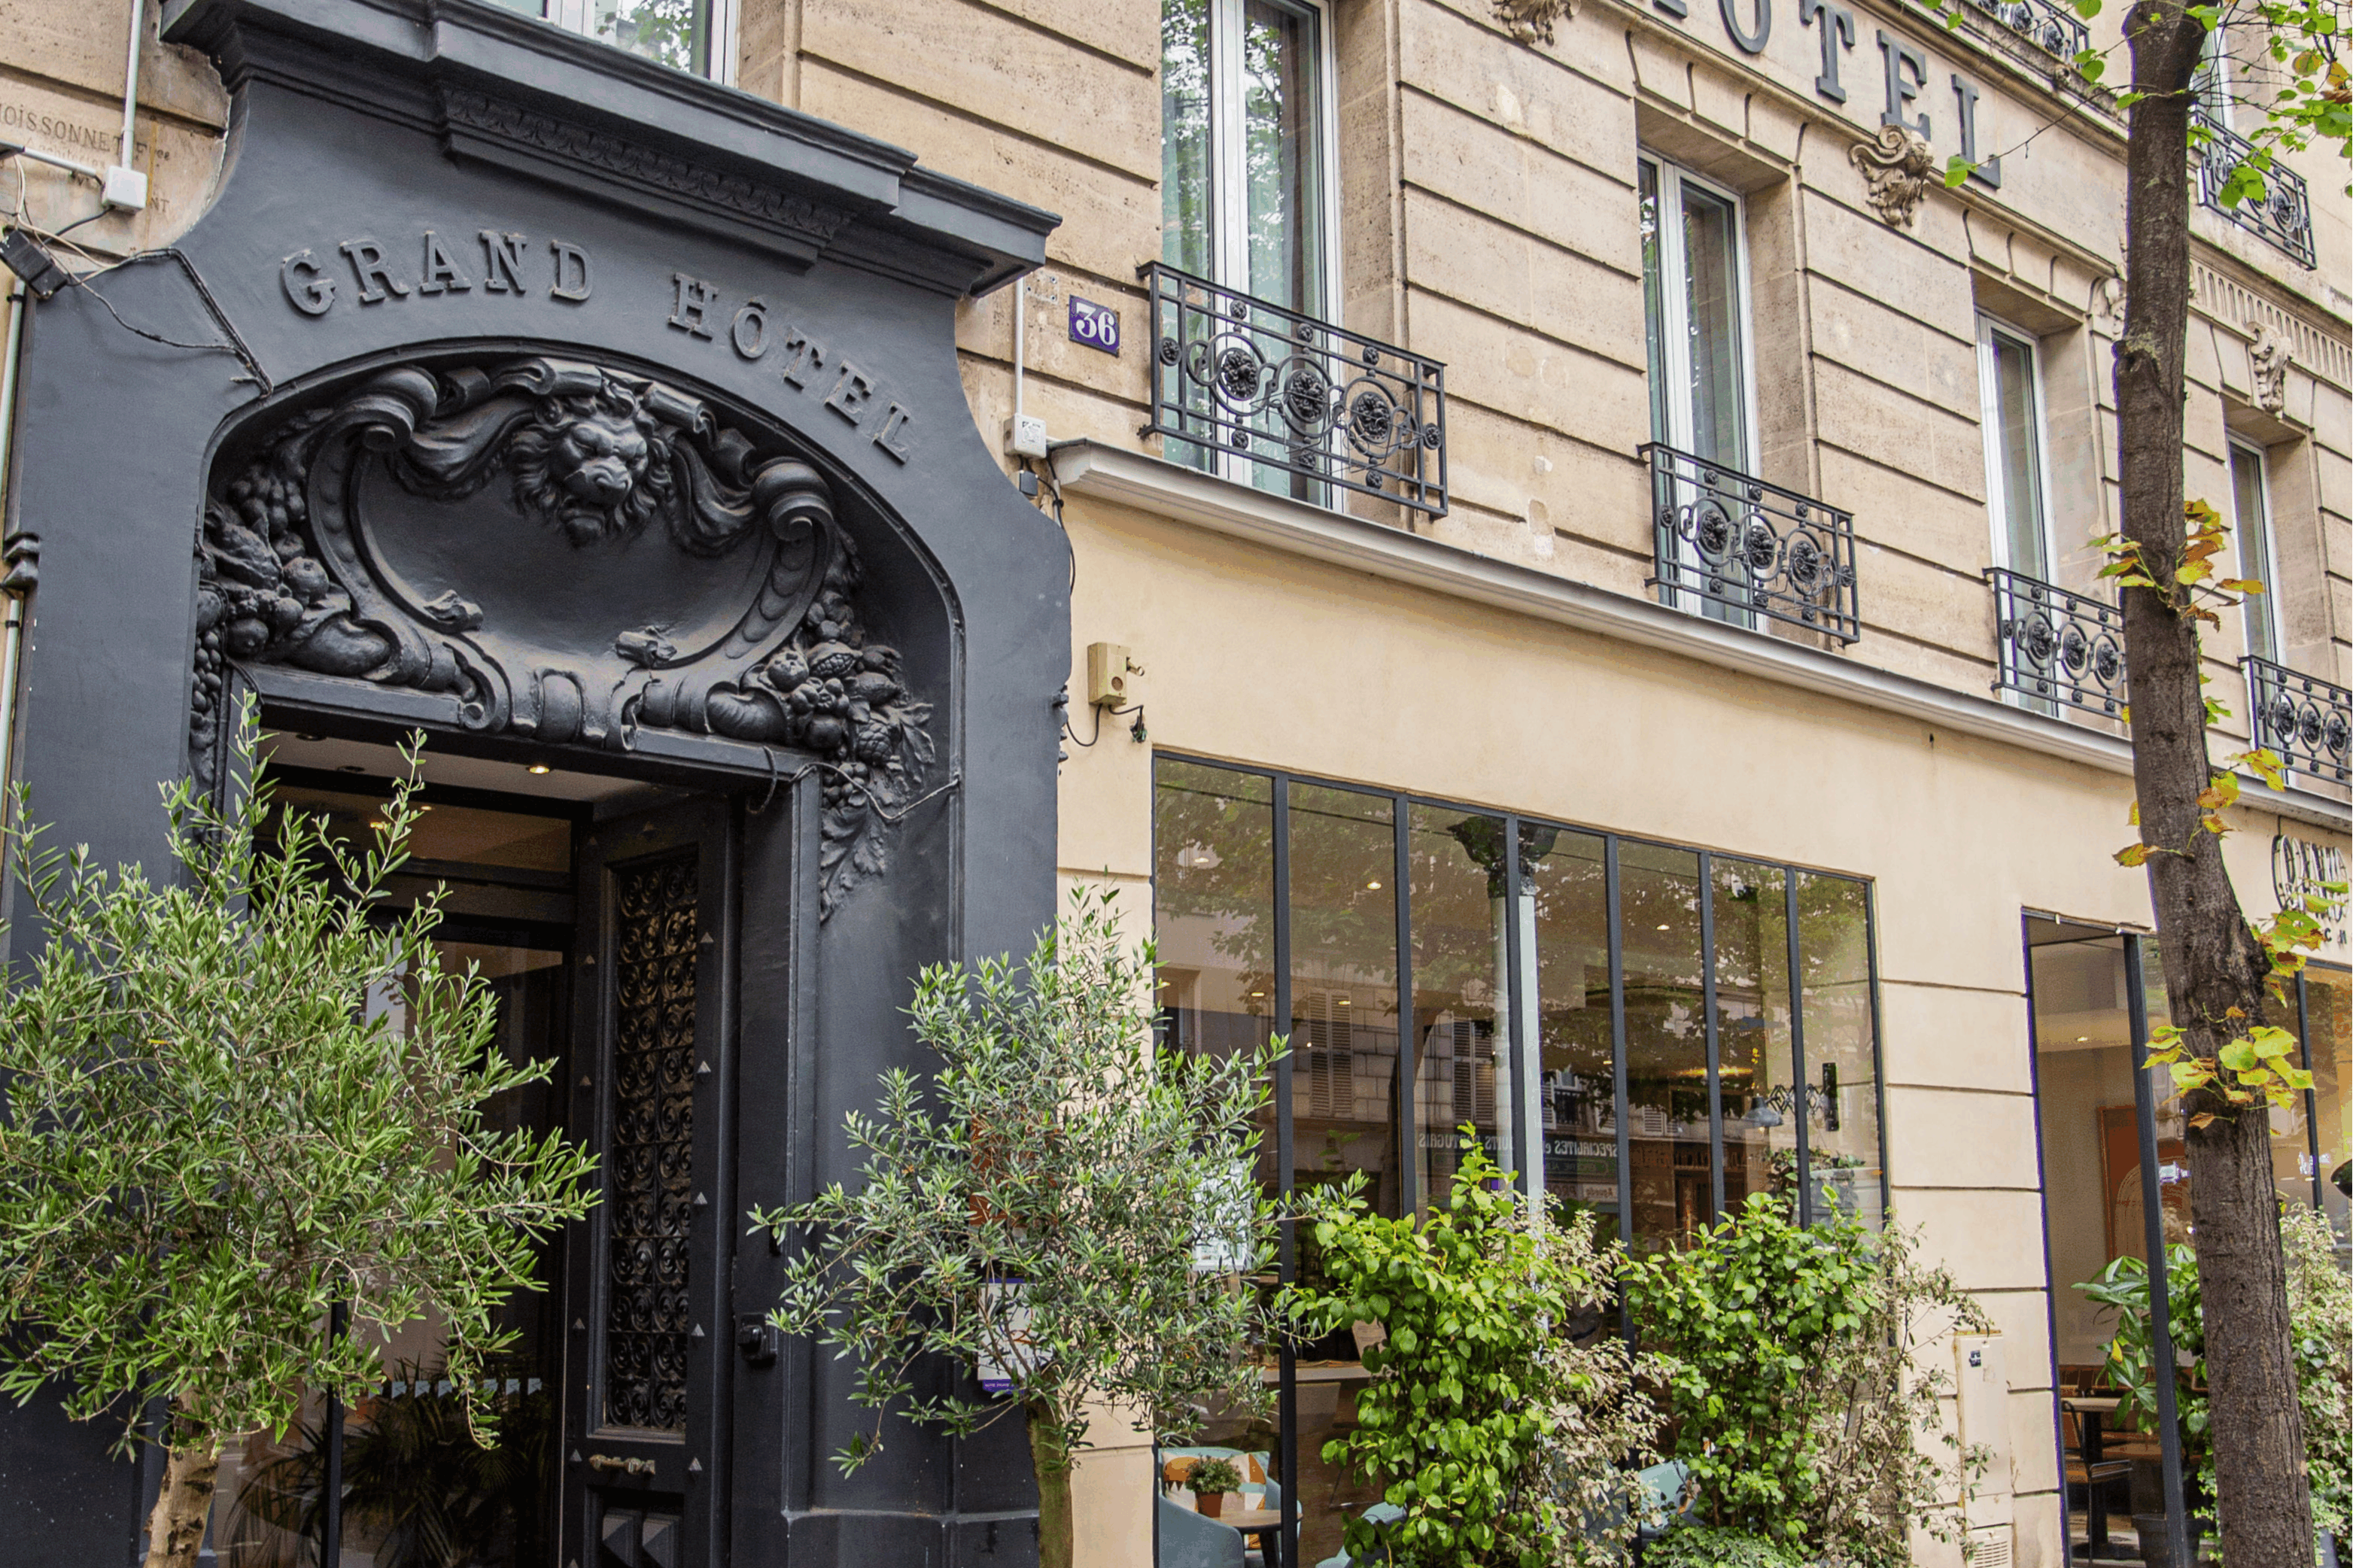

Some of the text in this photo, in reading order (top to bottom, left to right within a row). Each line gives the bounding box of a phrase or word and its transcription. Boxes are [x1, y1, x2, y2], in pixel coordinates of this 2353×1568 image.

[1651, 0, 2002, 189] OTEL
[281, 229, 912, 465] GRAND HÔTEL
[1075, 302, 1117, 346] 36
